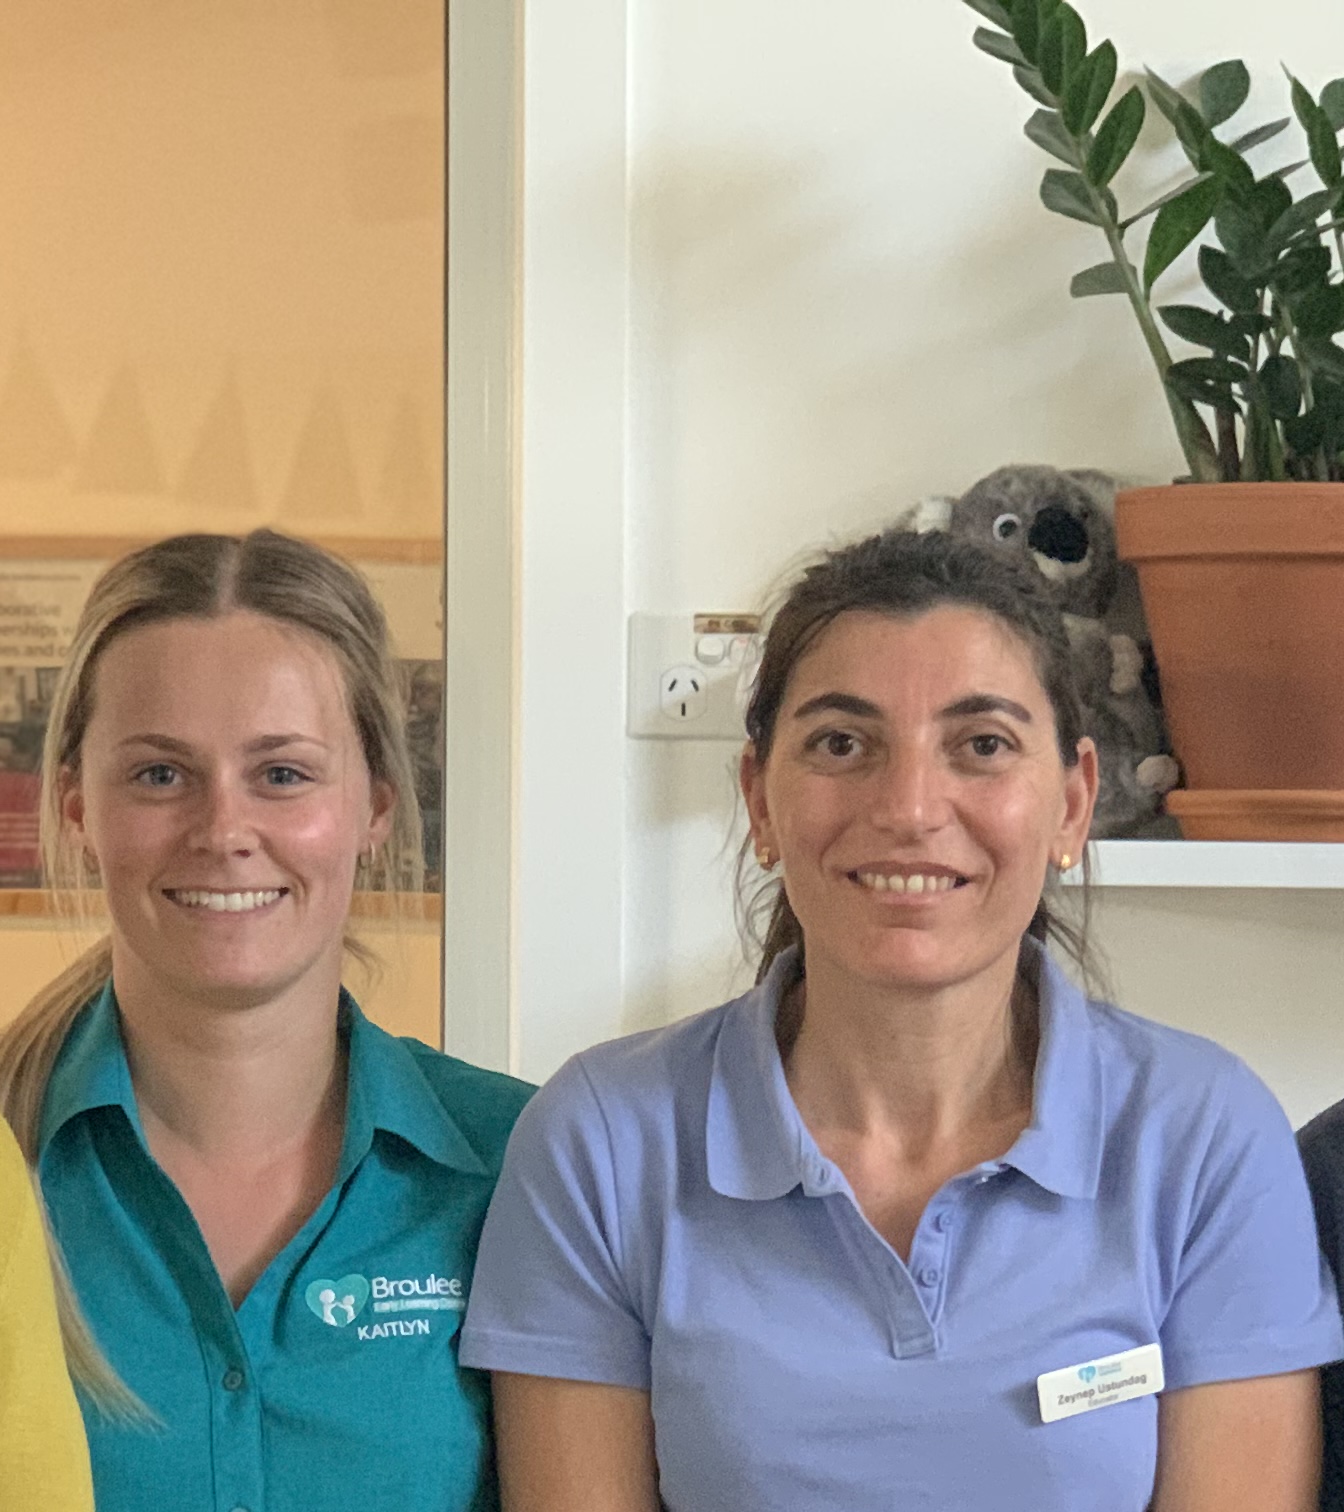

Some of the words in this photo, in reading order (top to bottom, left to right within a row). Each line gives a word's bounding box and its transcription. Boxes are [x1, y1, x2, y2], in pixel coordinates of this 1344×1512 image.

[25, 641, 55, 658] and
[371, 1273, 463, 1299] Broulee
[356, 1318, 431, 1341] KAITLYN
[1057, 1388, 1096, 1406] Zeynep
